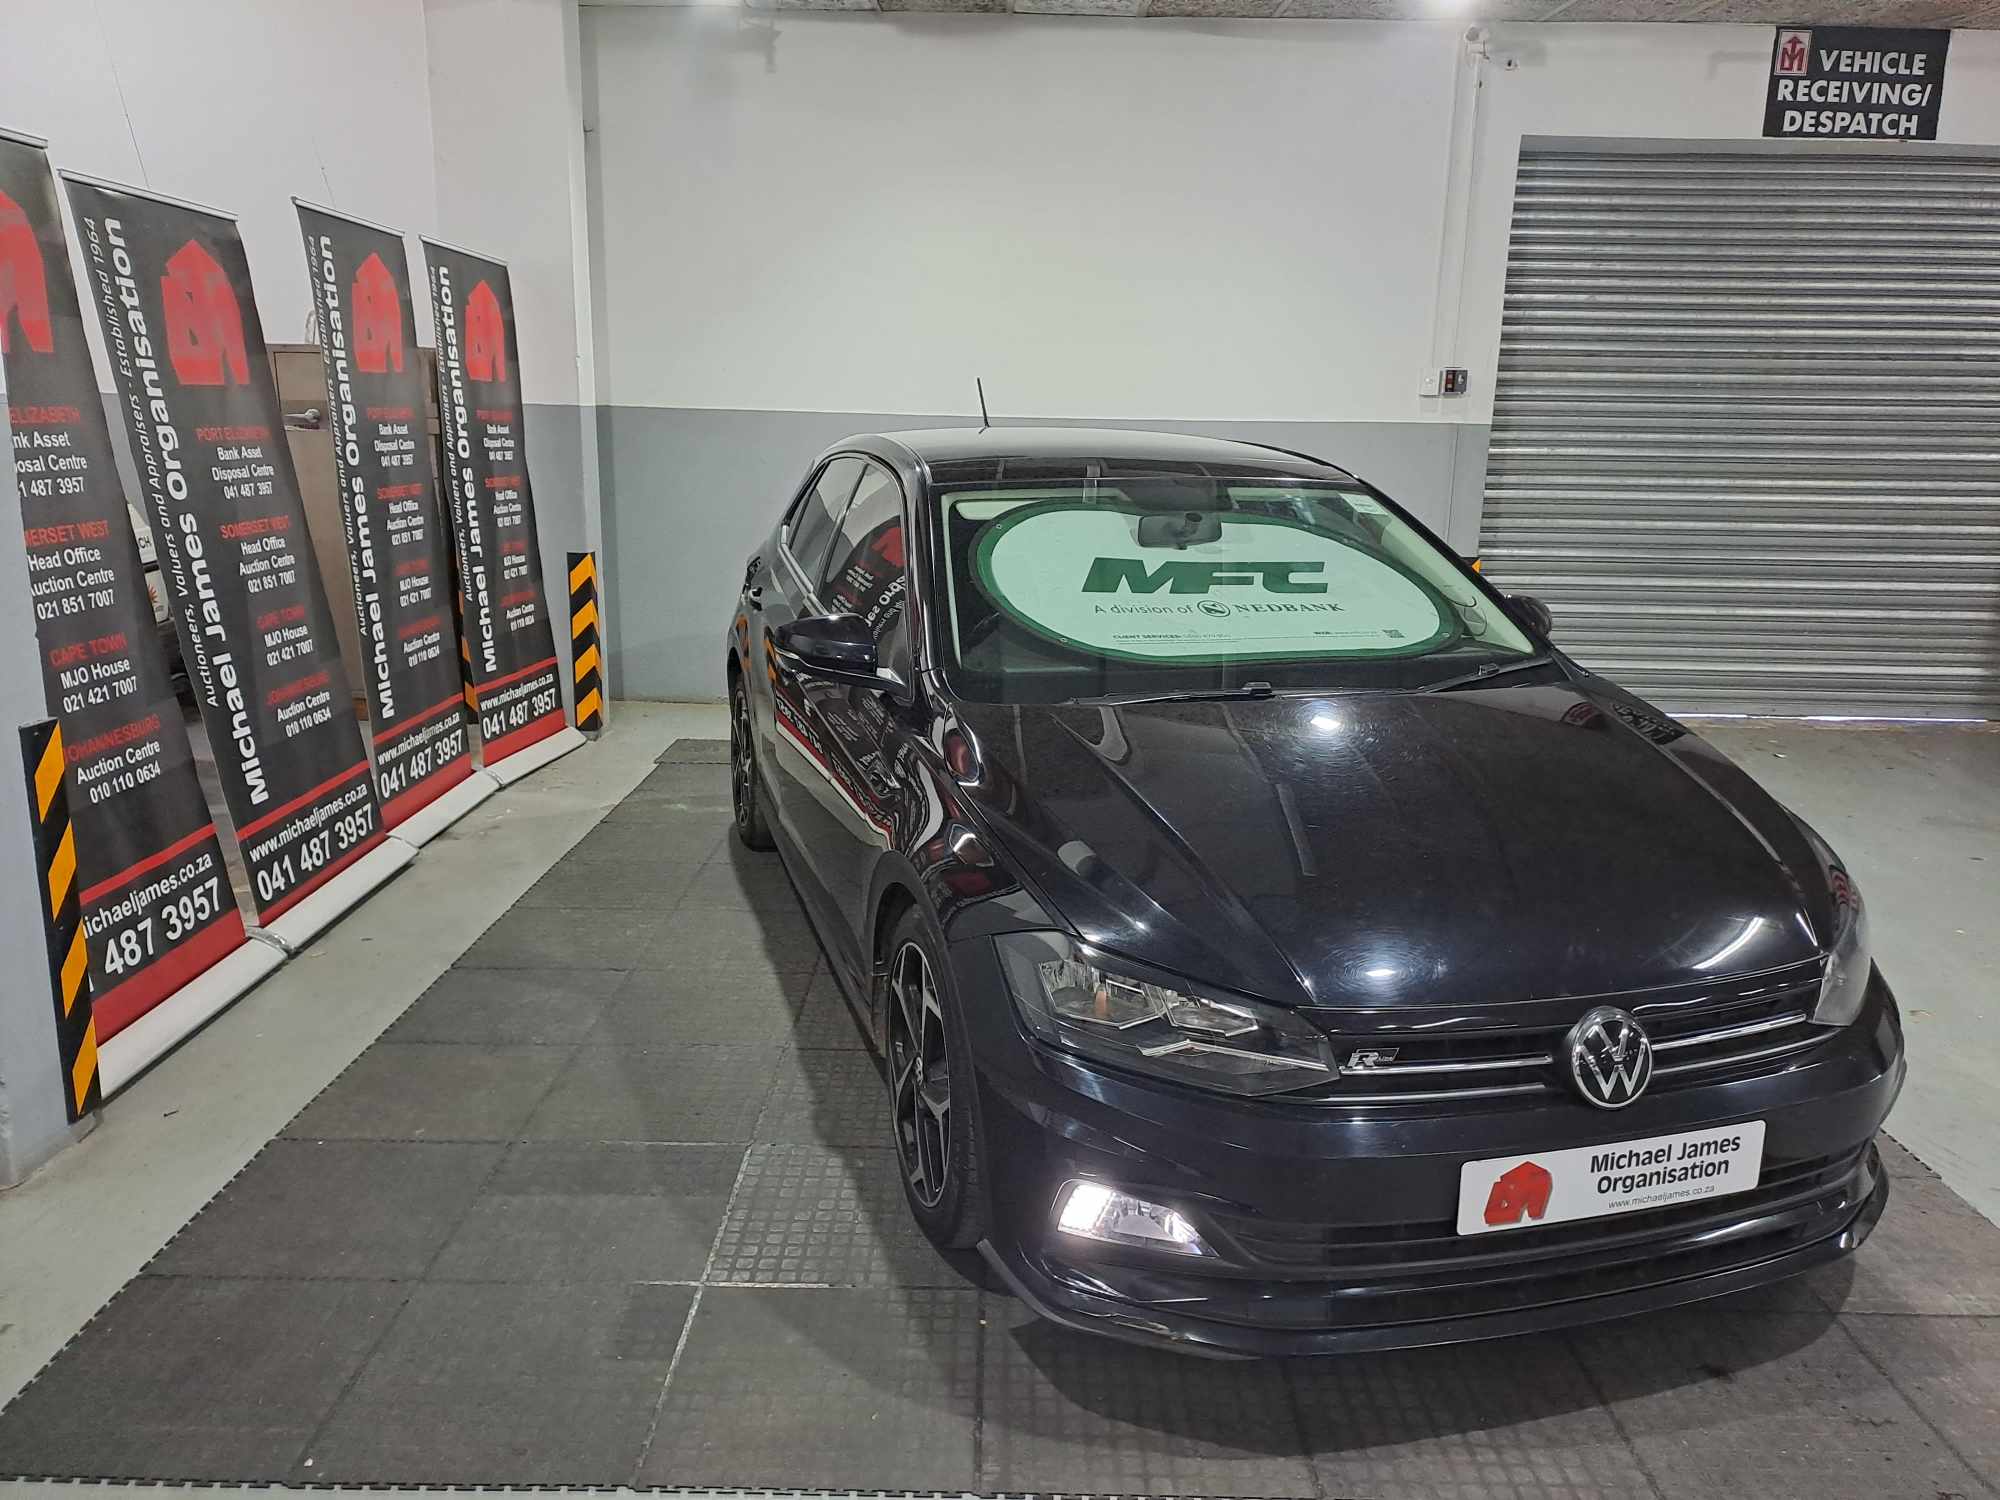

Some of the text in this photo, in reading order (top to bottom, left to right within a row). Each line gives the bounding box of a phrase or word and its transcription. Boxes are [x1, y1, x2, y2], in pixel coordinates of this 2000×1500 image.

[1820, 50, 1927, 75] VEHICLE
[1777, 79, 1933, 107] RECEIVING/
[1783, 110, 1918, 136] DESPATCH
[83, 216, 105, 264] 1964
[97, 270, 132, 377] Established
[13, 431, 71, 449] nk Asset
[130, 395, 160, 490] Appraisers
[217, 446, 263, 461] Bank Asset
[16, 454, 88, 473] osal Centre
[211, 464, 275, 482] Disposal Centre
[320, 235, 395, 719] Michael James Organisation
[439, 265, 497, 673] Michael James Organisation
[30, 479, 52, 497] 487
[56, 477, 85, 495] 3957
[223, 485, 239, 499] 041
[240, 484, 256, 497] 487
[105, 218, 269, 805] Michael James Organisation
[152, 494, 170, 528] and
[28, 546, 101, 572] Head Office
[241, 536, 286, 555] Head Office
[76, 568, 115, 587] Centre
[165, 533, 188, 597] Valuers
[240, 554, 296, 577] Auction Centre
[1081, 557, 1328, 594] MFC
[248, 578, 263, 594] 021
[263, 575, 278, 590] 851
[36, 588, 115, 620] 021 851 7007
[1094, 602, 1345, 614] A division of NEDBANK
[283, 625, 308, 642] House
[185, 604, 219, 707] Auctioneers,
[266, 651, 281, 667] 021
[281, 646, 295, 662] 421
[60, 658, 130, 689] MJO House
[63, 675, 138, 713] 021 421 7007
[277, 690, 331, 722] Auction Centre
[482, 688, 556, 739] 041 487 3957
[77, 739, 161, 785] Auction Centre
[380, 729, 462, 798] 041 487 3957
[89, 760, 161, 804] 010 110 0634
[249, 783, 368, 863] www.michaeljames.co.za
[257, 802, 374, 901] 041 487 3957
[83, 852, 213, 939] ichaeljames.co.za
[104, 876, 221, 975] 487 3957
[1590, 1134, 1741, 1173] Michael James
[1596, 1157, 1729, 1196] Organisation
[1608, 1183, 1716, 1209] www.michaeljames.co.za
